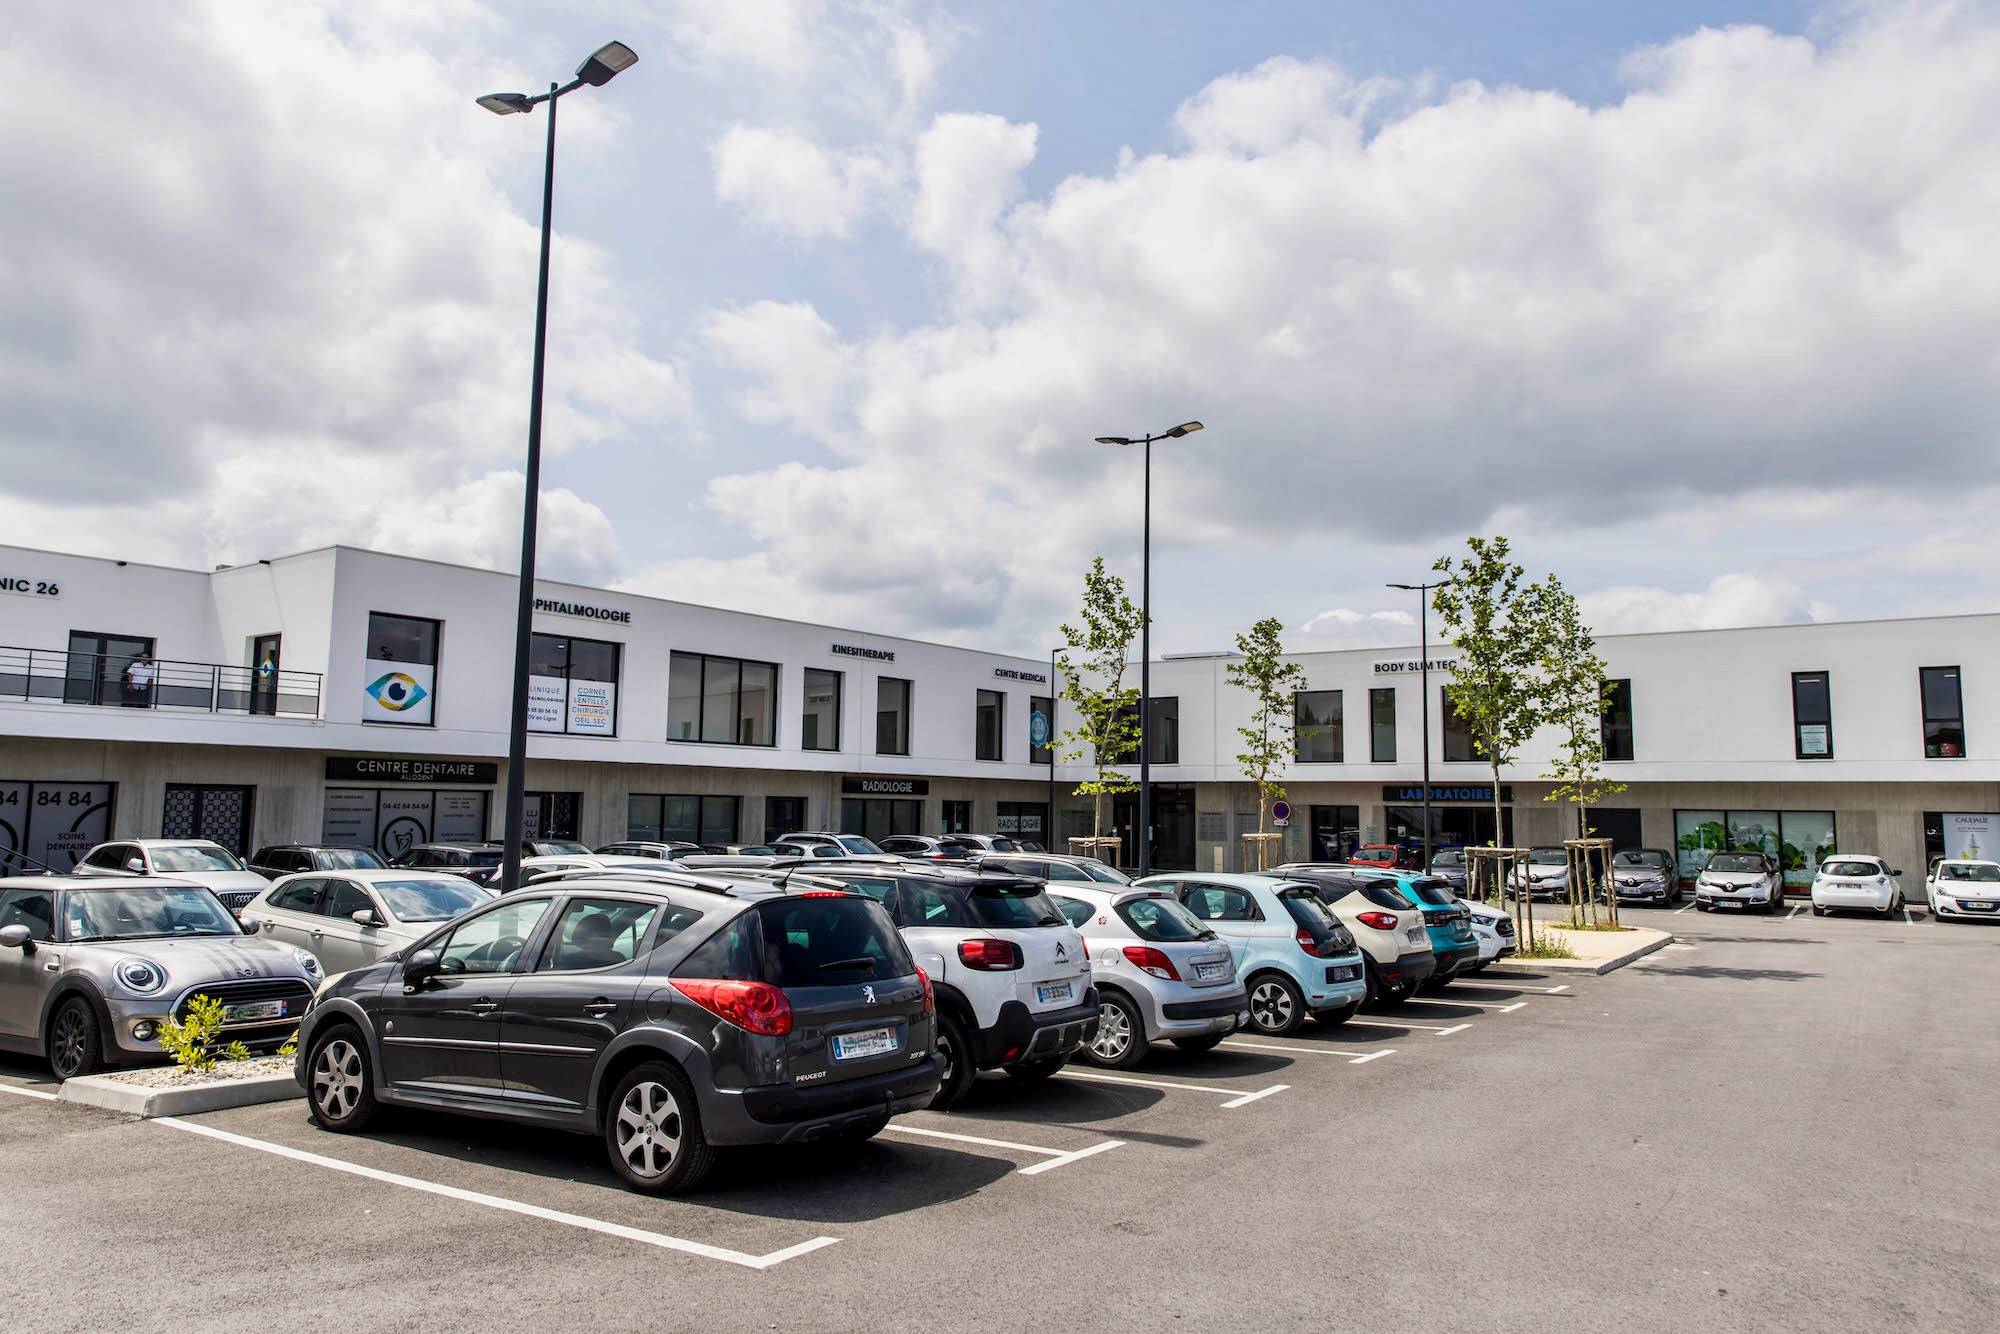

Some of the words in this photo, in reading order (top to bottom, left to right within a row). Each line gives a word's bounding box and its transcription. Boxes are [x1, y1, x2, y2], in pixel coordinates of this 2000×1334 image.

[36, 582, 59, 596] 26
[532, 599, 631, 623] PHTALMOLOGIE
[832, 644, 895, 662] KINESITHERAPIE
[1374, 663, 1404, 673] BODY
[1408, 661, 1433, 671] SLIM
[995, 668, 1018, 680] CENTRE
[1020, 672, 1046, 683] MEDICAL
[529, 686, 561, 694] LINIQUE
[573, 697, 609, 706] LENTILLES
[572, 706, 610, 716] CHIRURGIE
[574, 716, 590, 725] OEIL
[356, 760, 409, 773] CENTRE
[413, 762, 475, 776] DENTAIRE
[862, 780, 912, 792] RADIOLOGIE
[37, 791, 61, 806] 84
[68, 791, 92, 806] 84
[1400, 788, 1492, 800] LABORATOIRE
[997, 818, 1041, 829] RADIOOGIE
[57, 832, 87, 841] SOINS
[795, 1071, 827, 1082] PEUGEOT
